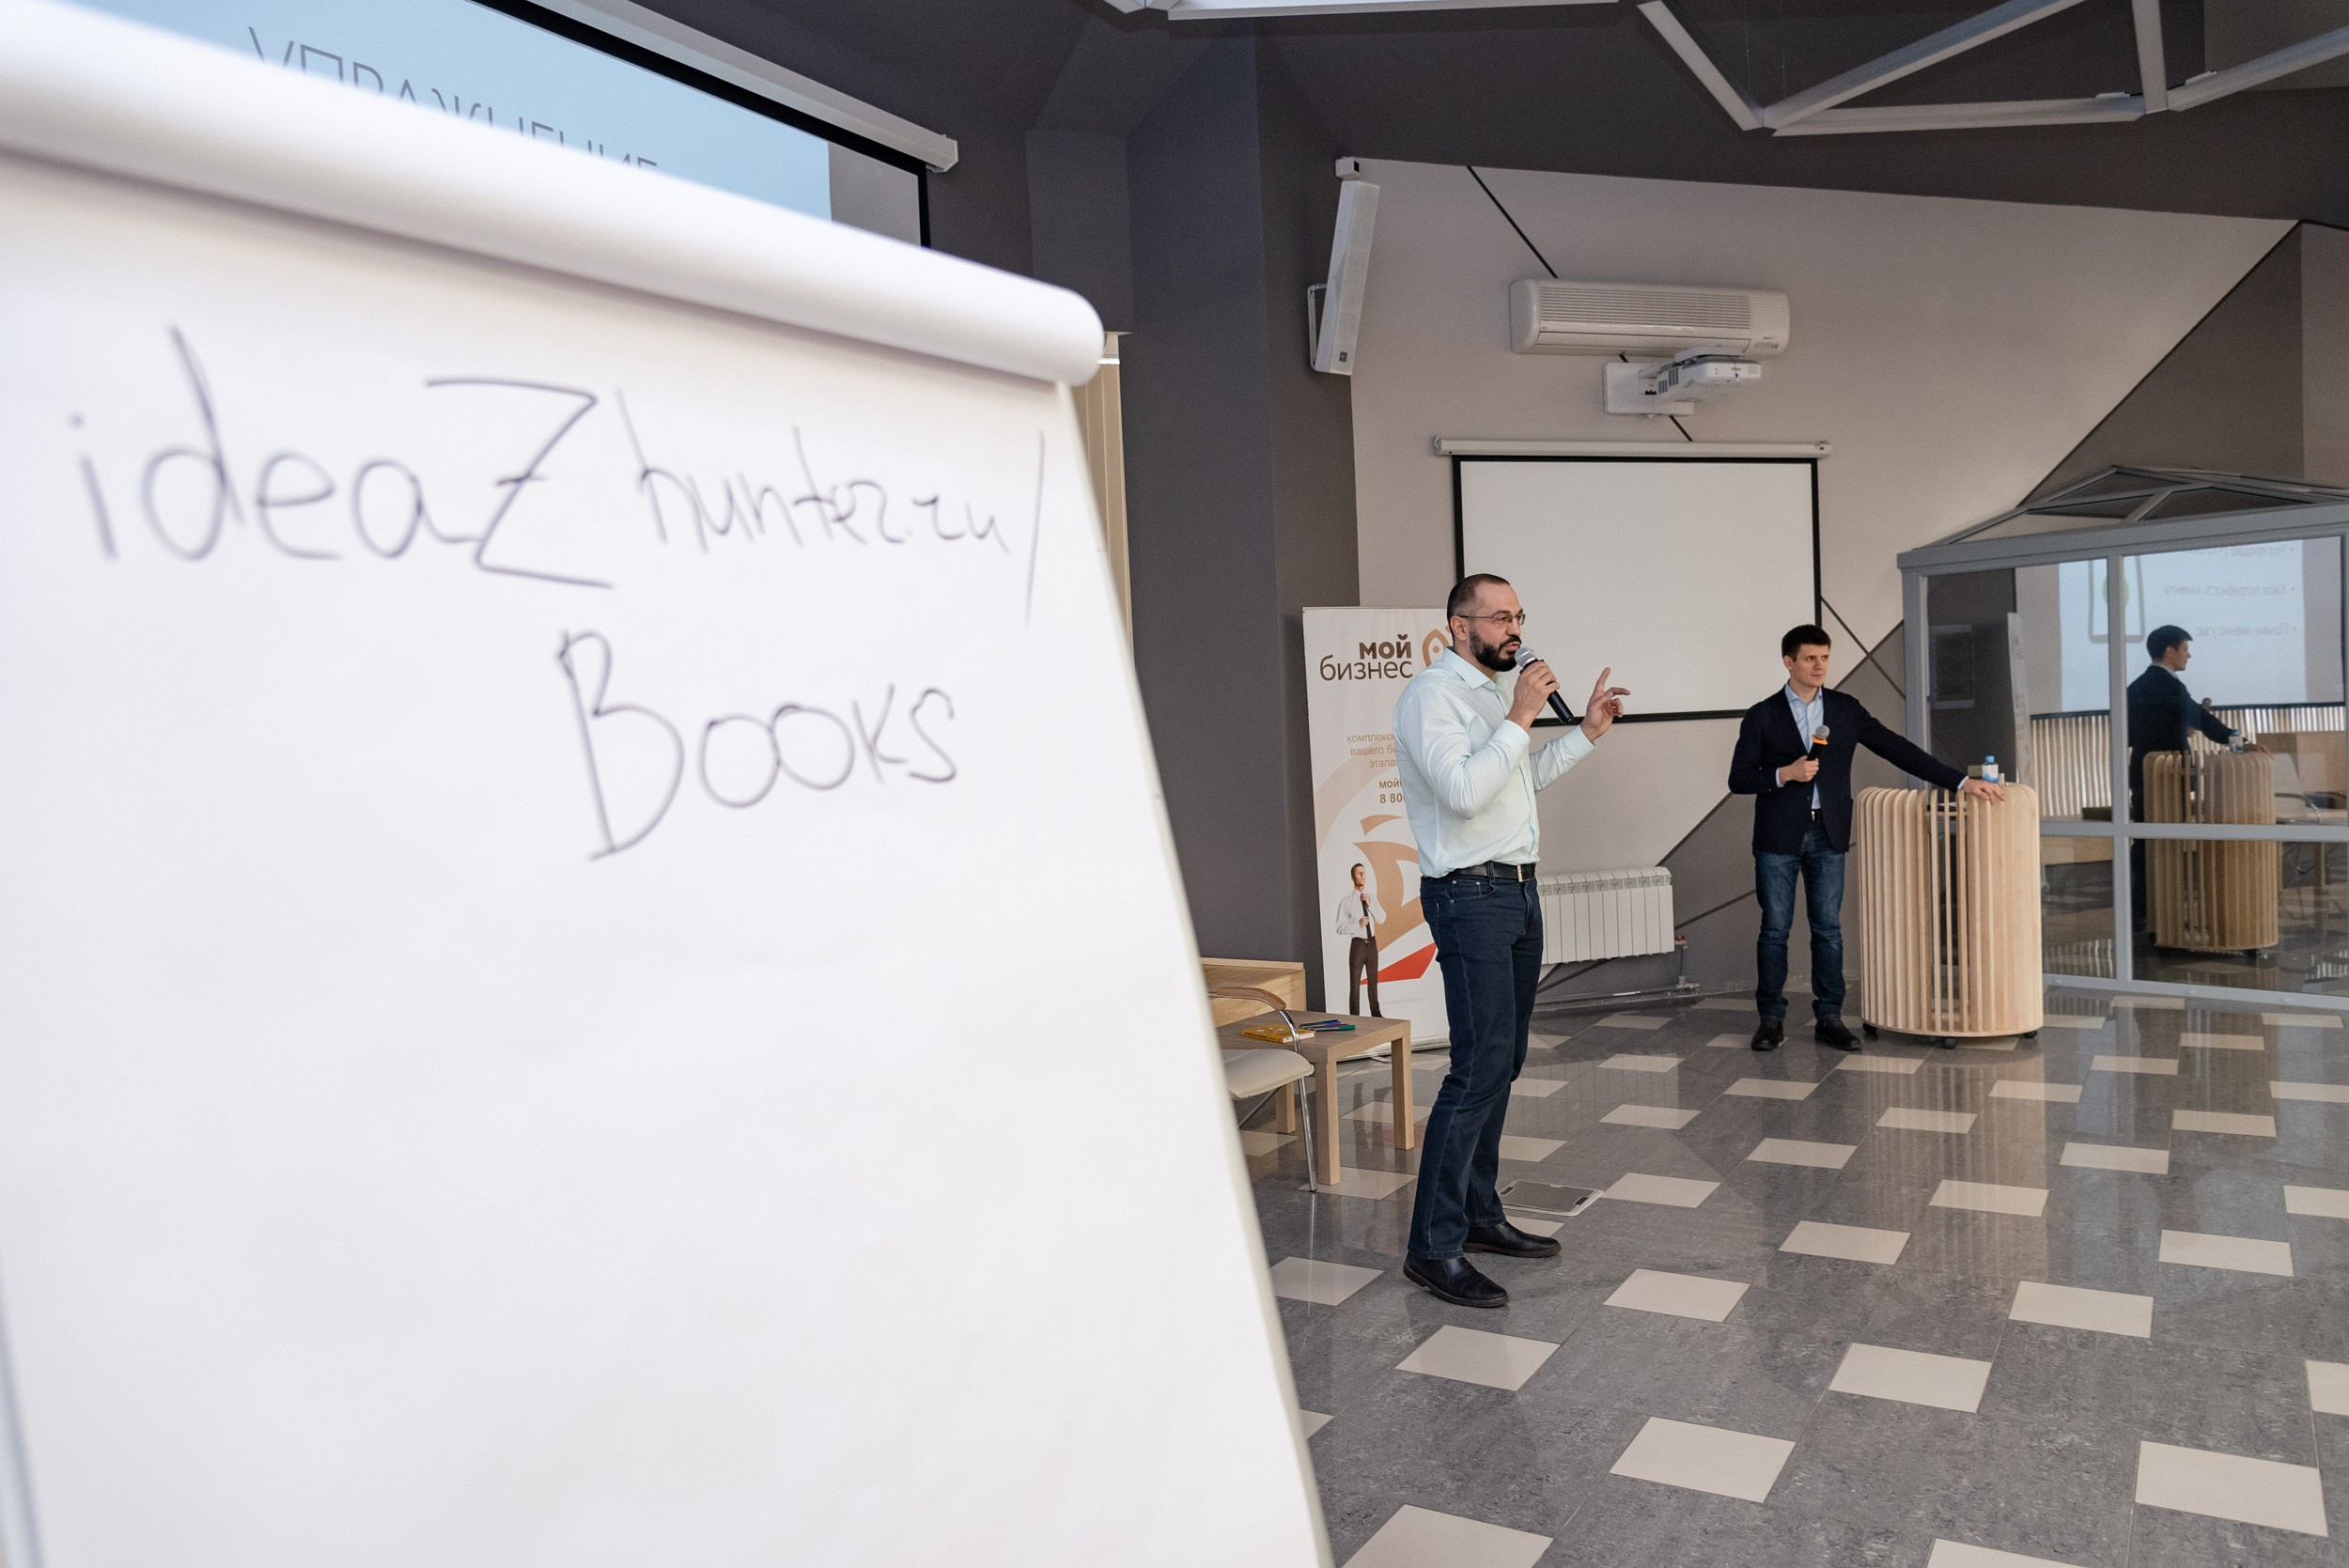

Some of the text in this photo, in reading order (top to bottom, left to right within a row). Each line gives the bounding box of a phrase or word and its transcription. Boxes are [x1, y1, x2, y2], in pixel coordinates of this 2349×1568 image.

[1359, 633, 1412, 660] мой
[1319, 654, 1413, 681] бизнес
[1350, 747, 1385, 756] вашего
[1369, 759, 1398, 768] этапа
[1379, 792, 1405, 804] 8 80
